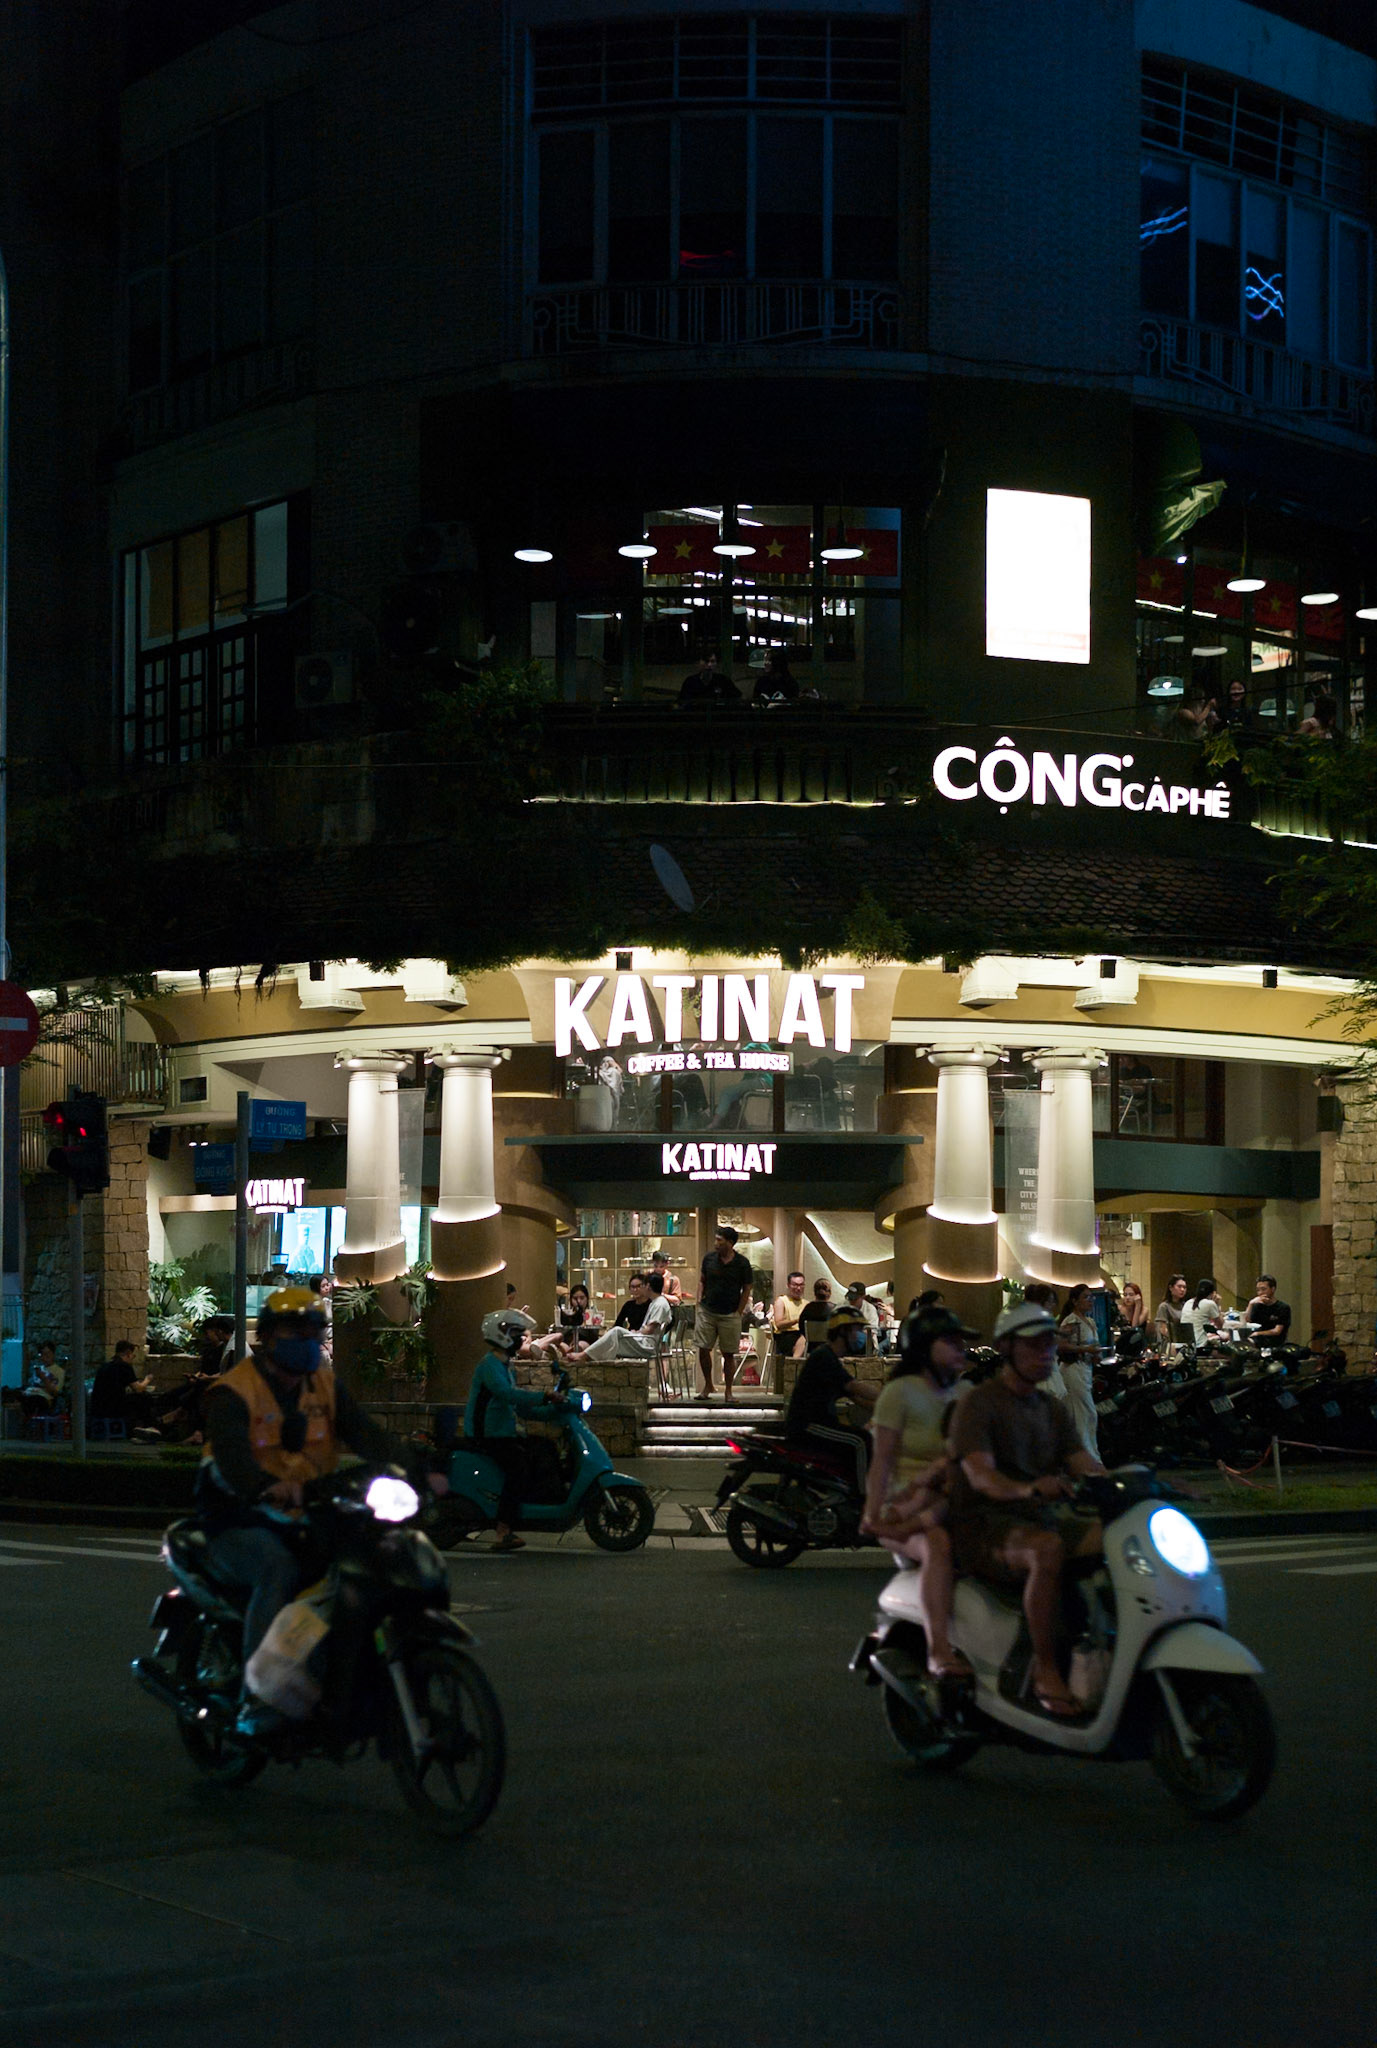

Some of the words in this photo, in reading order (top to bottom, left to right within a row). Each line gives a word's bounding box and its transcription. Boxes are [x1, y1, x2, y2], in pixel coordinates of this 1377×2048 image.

[932, 737, 1124, 814] CỘNG
[555, 974, 865, 1057] KATINAT
[627, 1052, 685, 1074] COFFEE
[686, 1053, 702, 1069] &
[704, 1052, 737, 1069] TEA
[738, 1053, 790, 1071] HOUSE
[661, 1142, 778, 1176] KATINAT
[1023, 1179, 1035, 1188] THE
